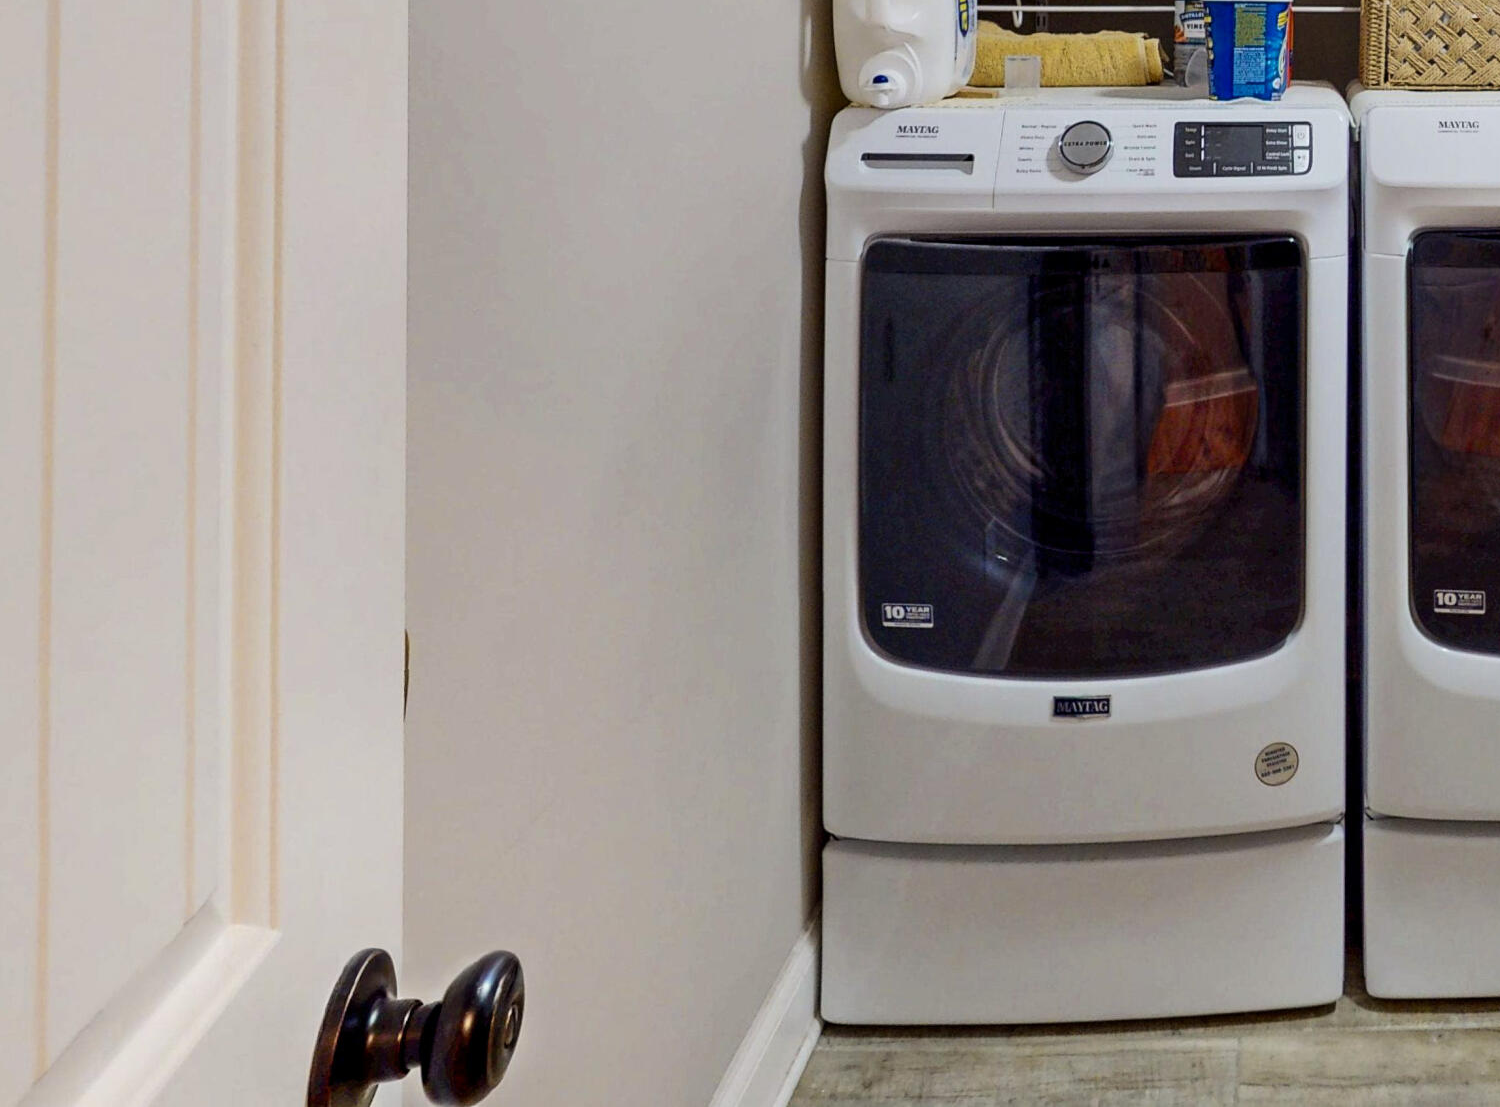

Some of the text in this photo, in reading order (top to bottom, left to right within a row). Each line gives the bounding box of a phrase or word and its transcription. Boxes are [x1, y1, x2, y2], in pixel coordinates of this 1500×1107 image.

[896, 124, 940, 134] MAYTAG
[1438, 120, 1480, 129] MAYTAG
[1436, 592, 1457, 606] 10
[884, 605, 905, 620] 10
[1057, 700, 1109, 713] MAYTAG
